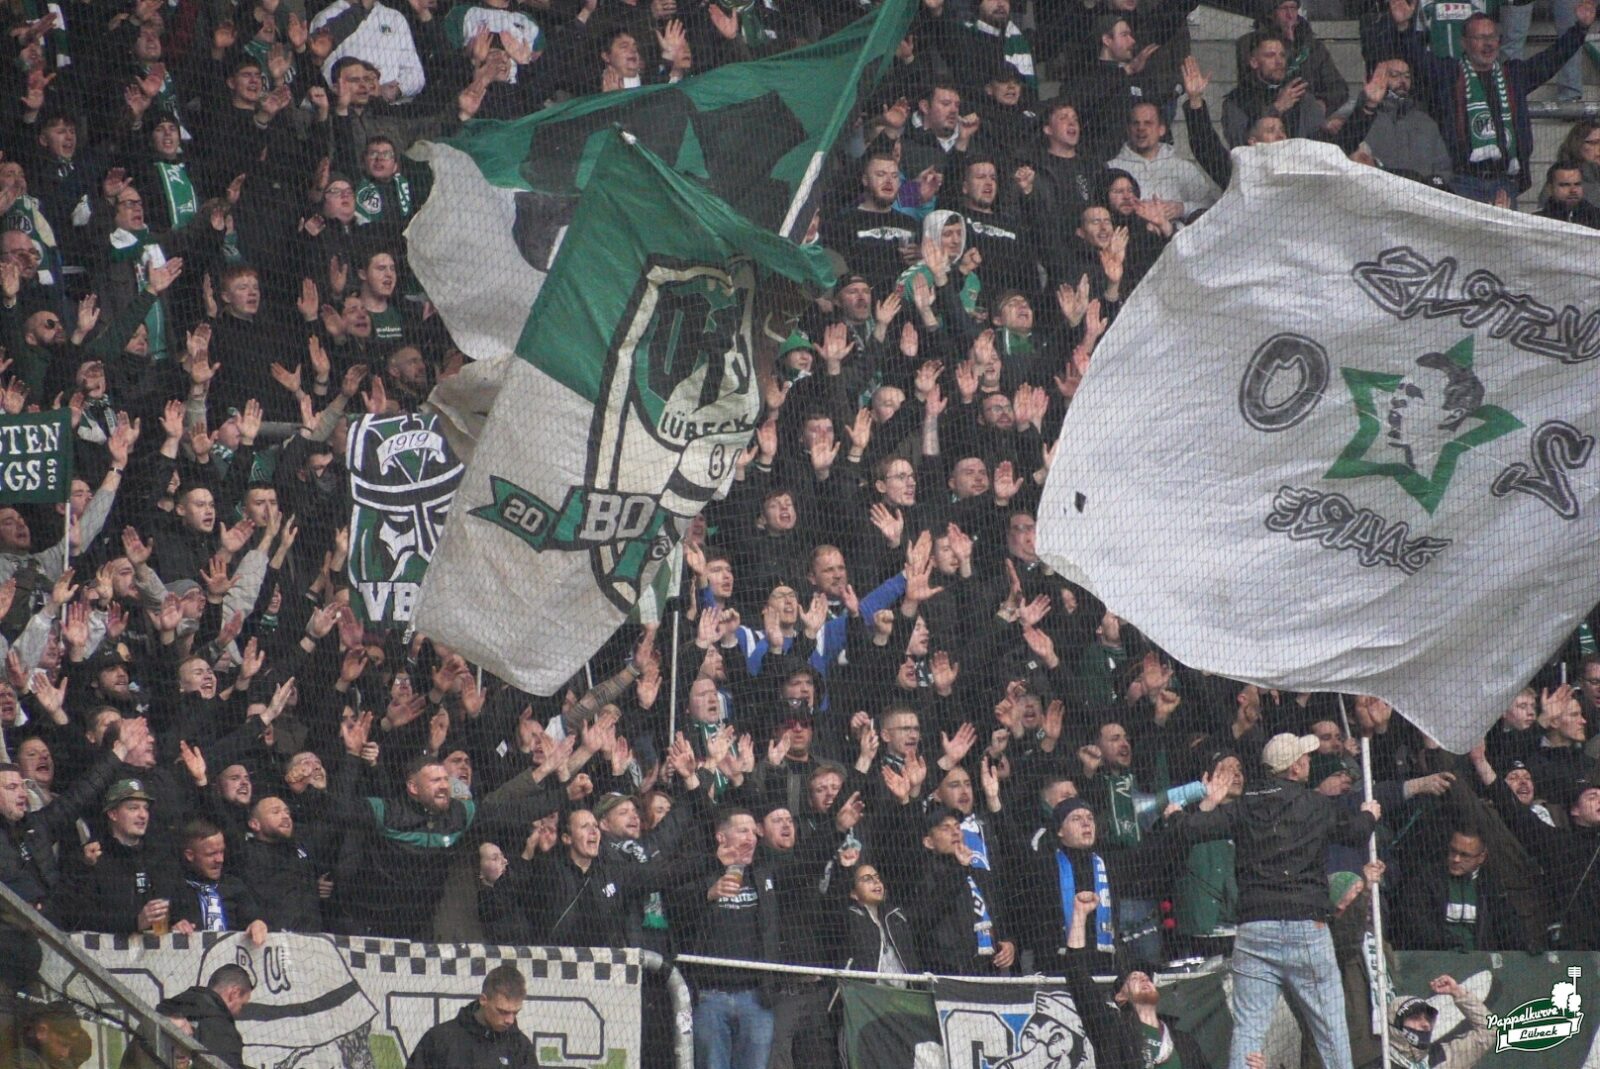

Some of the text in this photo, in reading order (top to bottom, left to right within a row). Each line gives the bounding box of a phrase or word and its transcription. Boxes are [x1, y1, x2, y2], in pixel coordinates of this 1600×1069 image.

[0, 422, 61, 455] TEN
[387, 432, 429, 454] 1919
[0, 459, 41, 491] GS
[503, 498, 544, 534] 20
